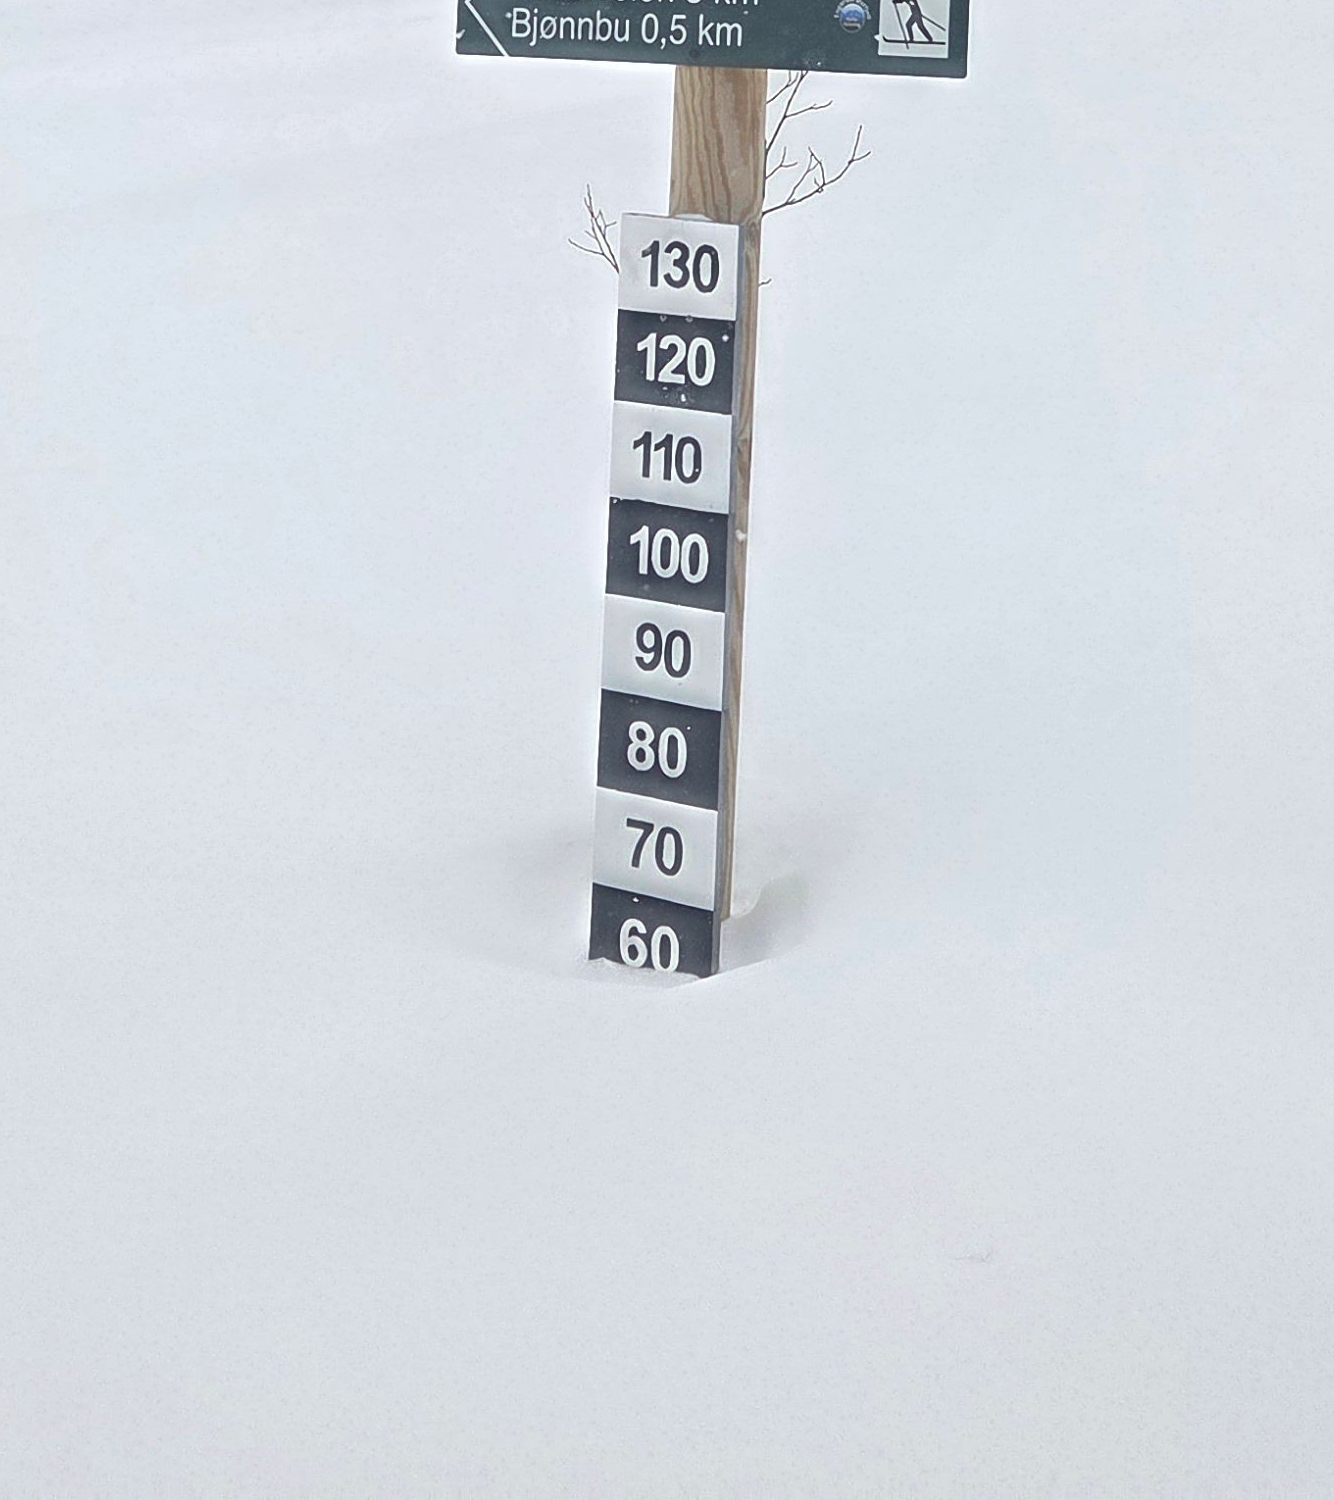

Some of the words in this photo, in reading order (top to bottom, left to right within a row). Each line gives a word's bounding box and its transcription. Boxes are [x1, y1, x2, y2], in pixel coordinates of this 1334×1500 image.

[510, 7, 631, 48] Bjønnbu
[641, 13, 688, 50] 0,5
[698, 15, 743, 47] km
[641, 240, 720, 293] 130
[636, 332, 715, 387] 120
[632, 430, 702, 484] 110
[629, 525, 709, 584] 100
[635, 622, 691, 678] 90
[627, 720, 688, 779] 80
[626, 818, 683, 877] 70
[619, 918, 680, 973] 60
